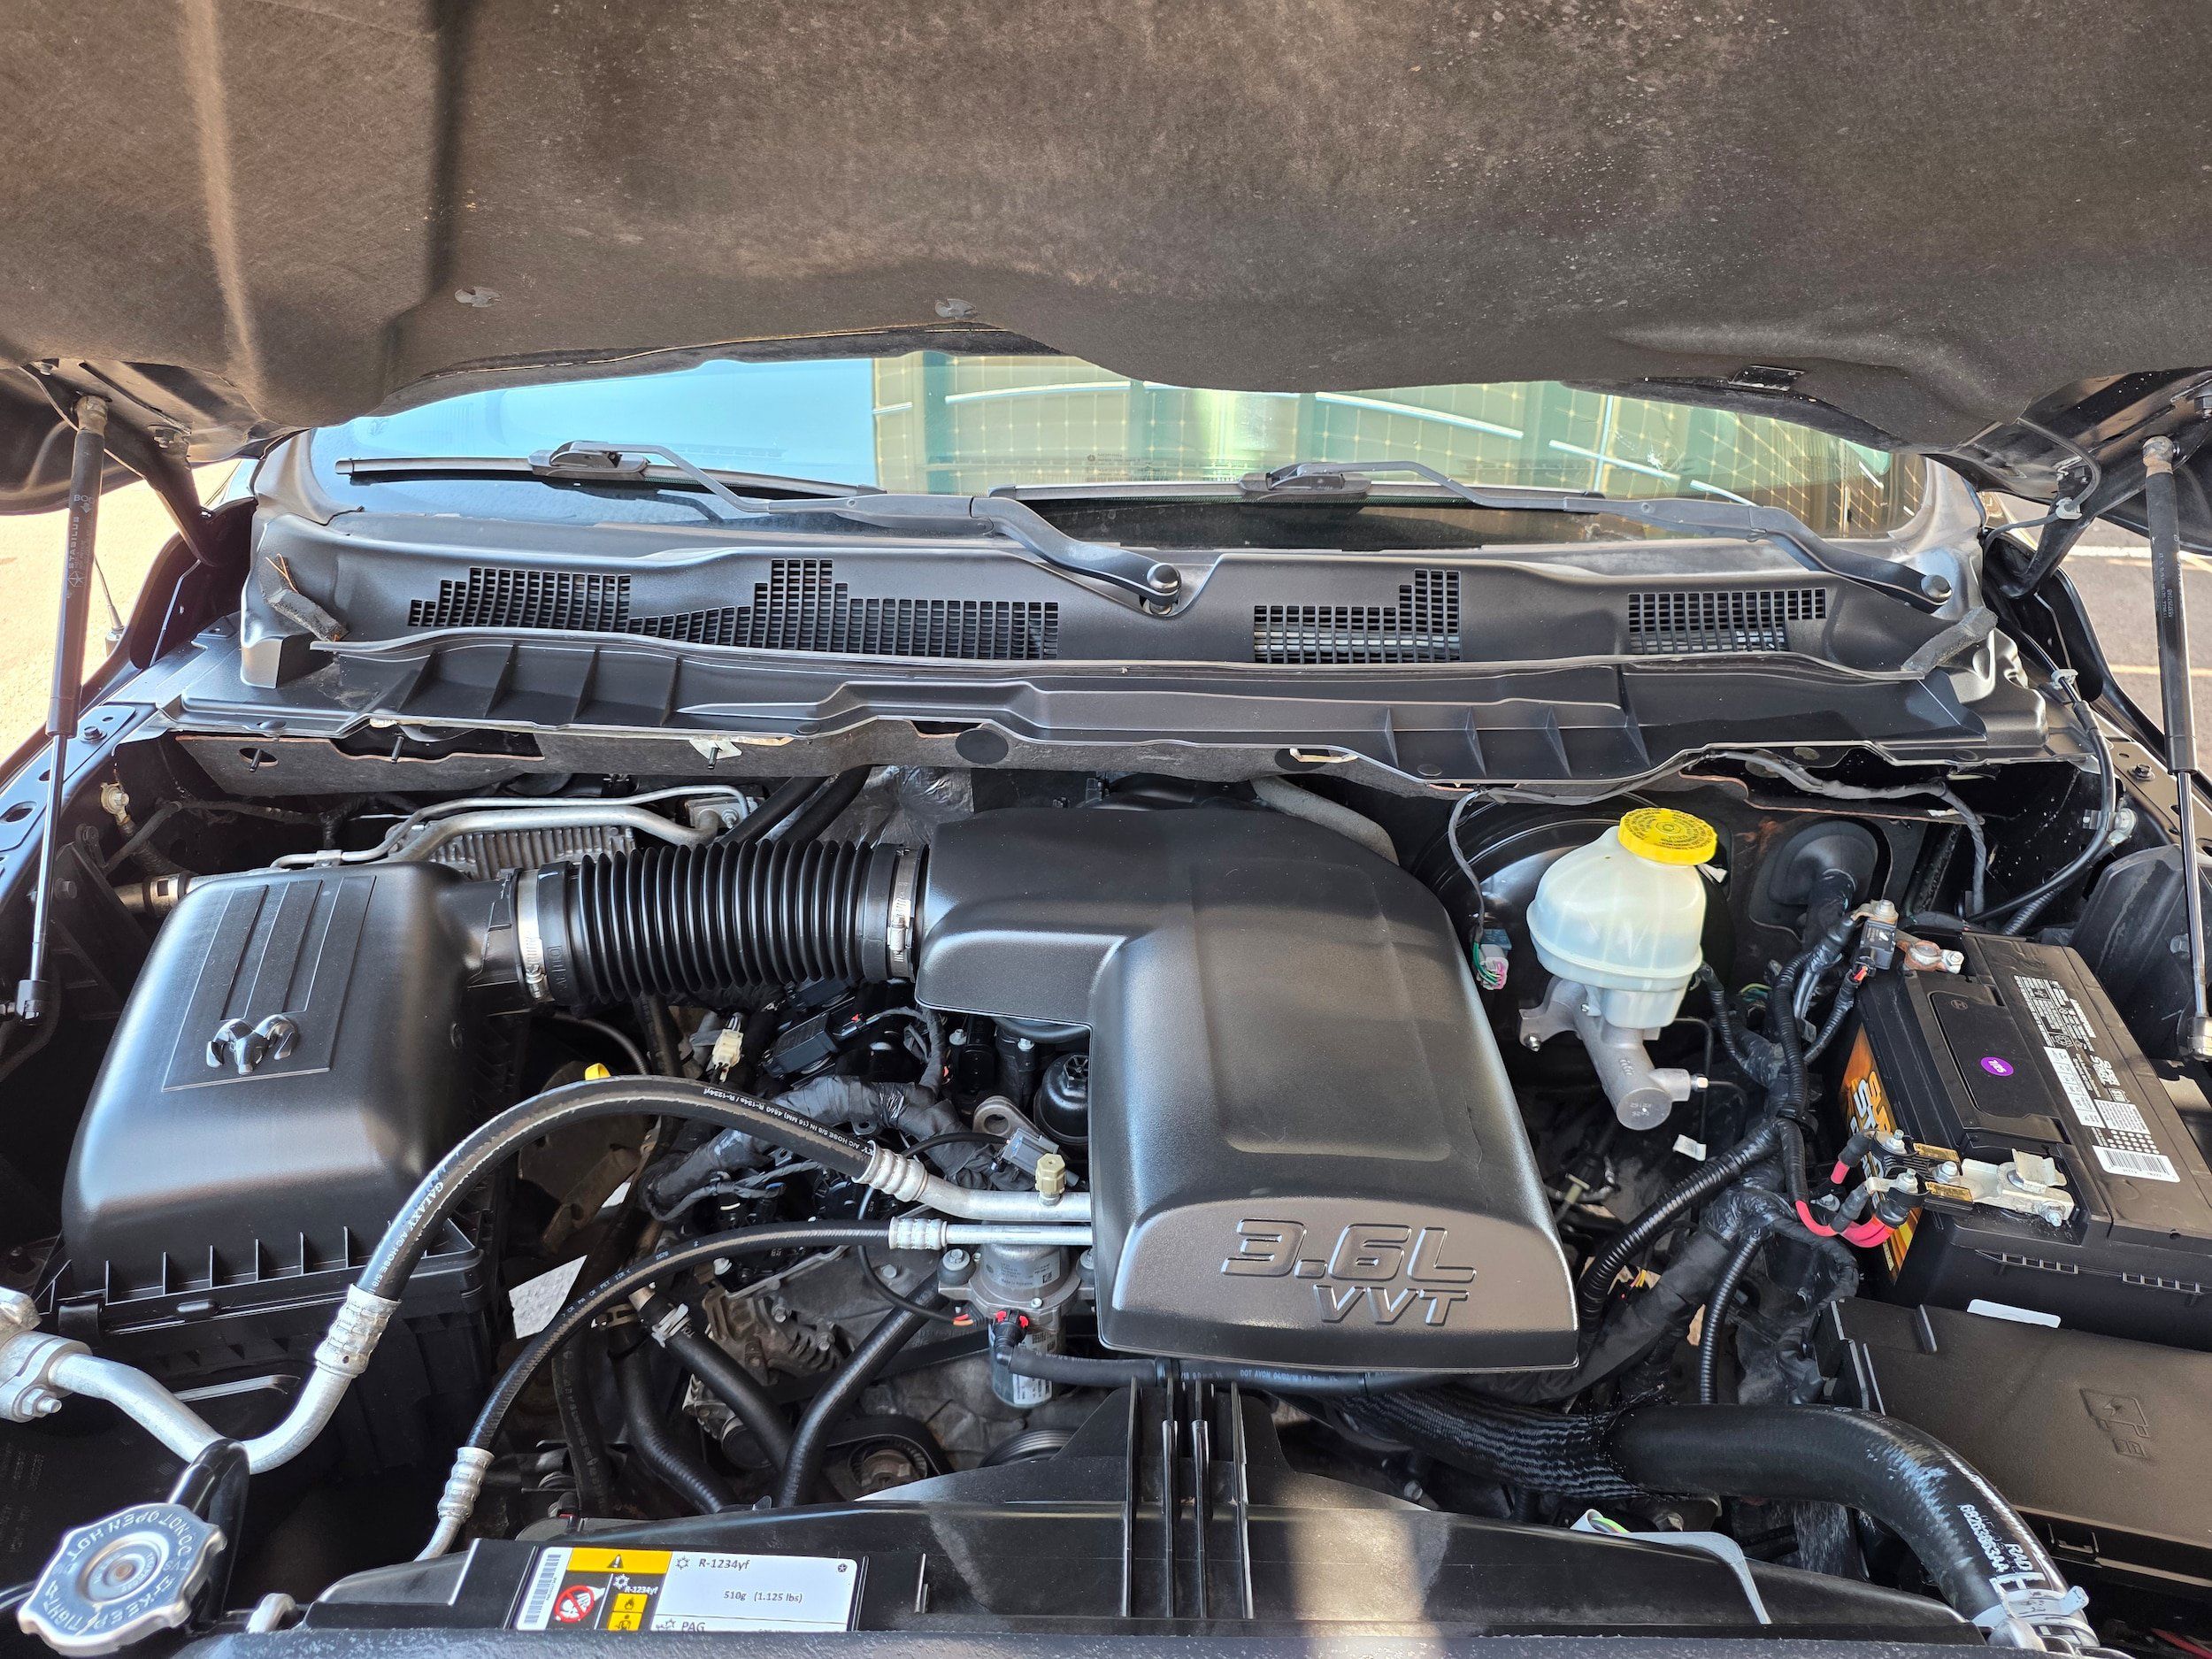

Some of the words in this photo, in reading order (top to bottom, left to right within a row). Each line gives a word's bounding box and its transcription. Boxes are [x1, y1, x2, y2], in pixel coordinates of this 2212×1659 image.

[69, 516, 80, 569] STABILUS
[703, 1087, 736, 1102] R-1234yf
[828, 1133, 848, 1144] HOSE
[408, 1181, 444, 1231] GALAXY
[398, 1232, 409, 1248] A/C
[1221, 1217, 1477, 1283] 3.6L
[380, 1247, 399, 1273] HOSE
[371, 1274, 383, 1287] 5/8
[1313, 1283, 1470, 1326] VVT
[1240, 1369, 1252, 1378] DOT
[108, 1509, 160, 1533] OPEN
[158, 1513, 194, 1536] NOT
[67, 1528, 104, 1563] HOT
[2004, 1543, 2033, 1571] RAD
[698, 1557, 750, 1571] R-1234yf
[625, 1585, 658, 1595] R-1234yf
[723, 1590, 748, 1601] 510g
[754, 1591, 783, 1602] (1.125
[786, 1592, 803, 1603] lbs)
[42, 1595, 83, 1632] TIGHT
[93, 1594, 155, 1630] KEEP
[681, 1621, 706, 1632] PAG
